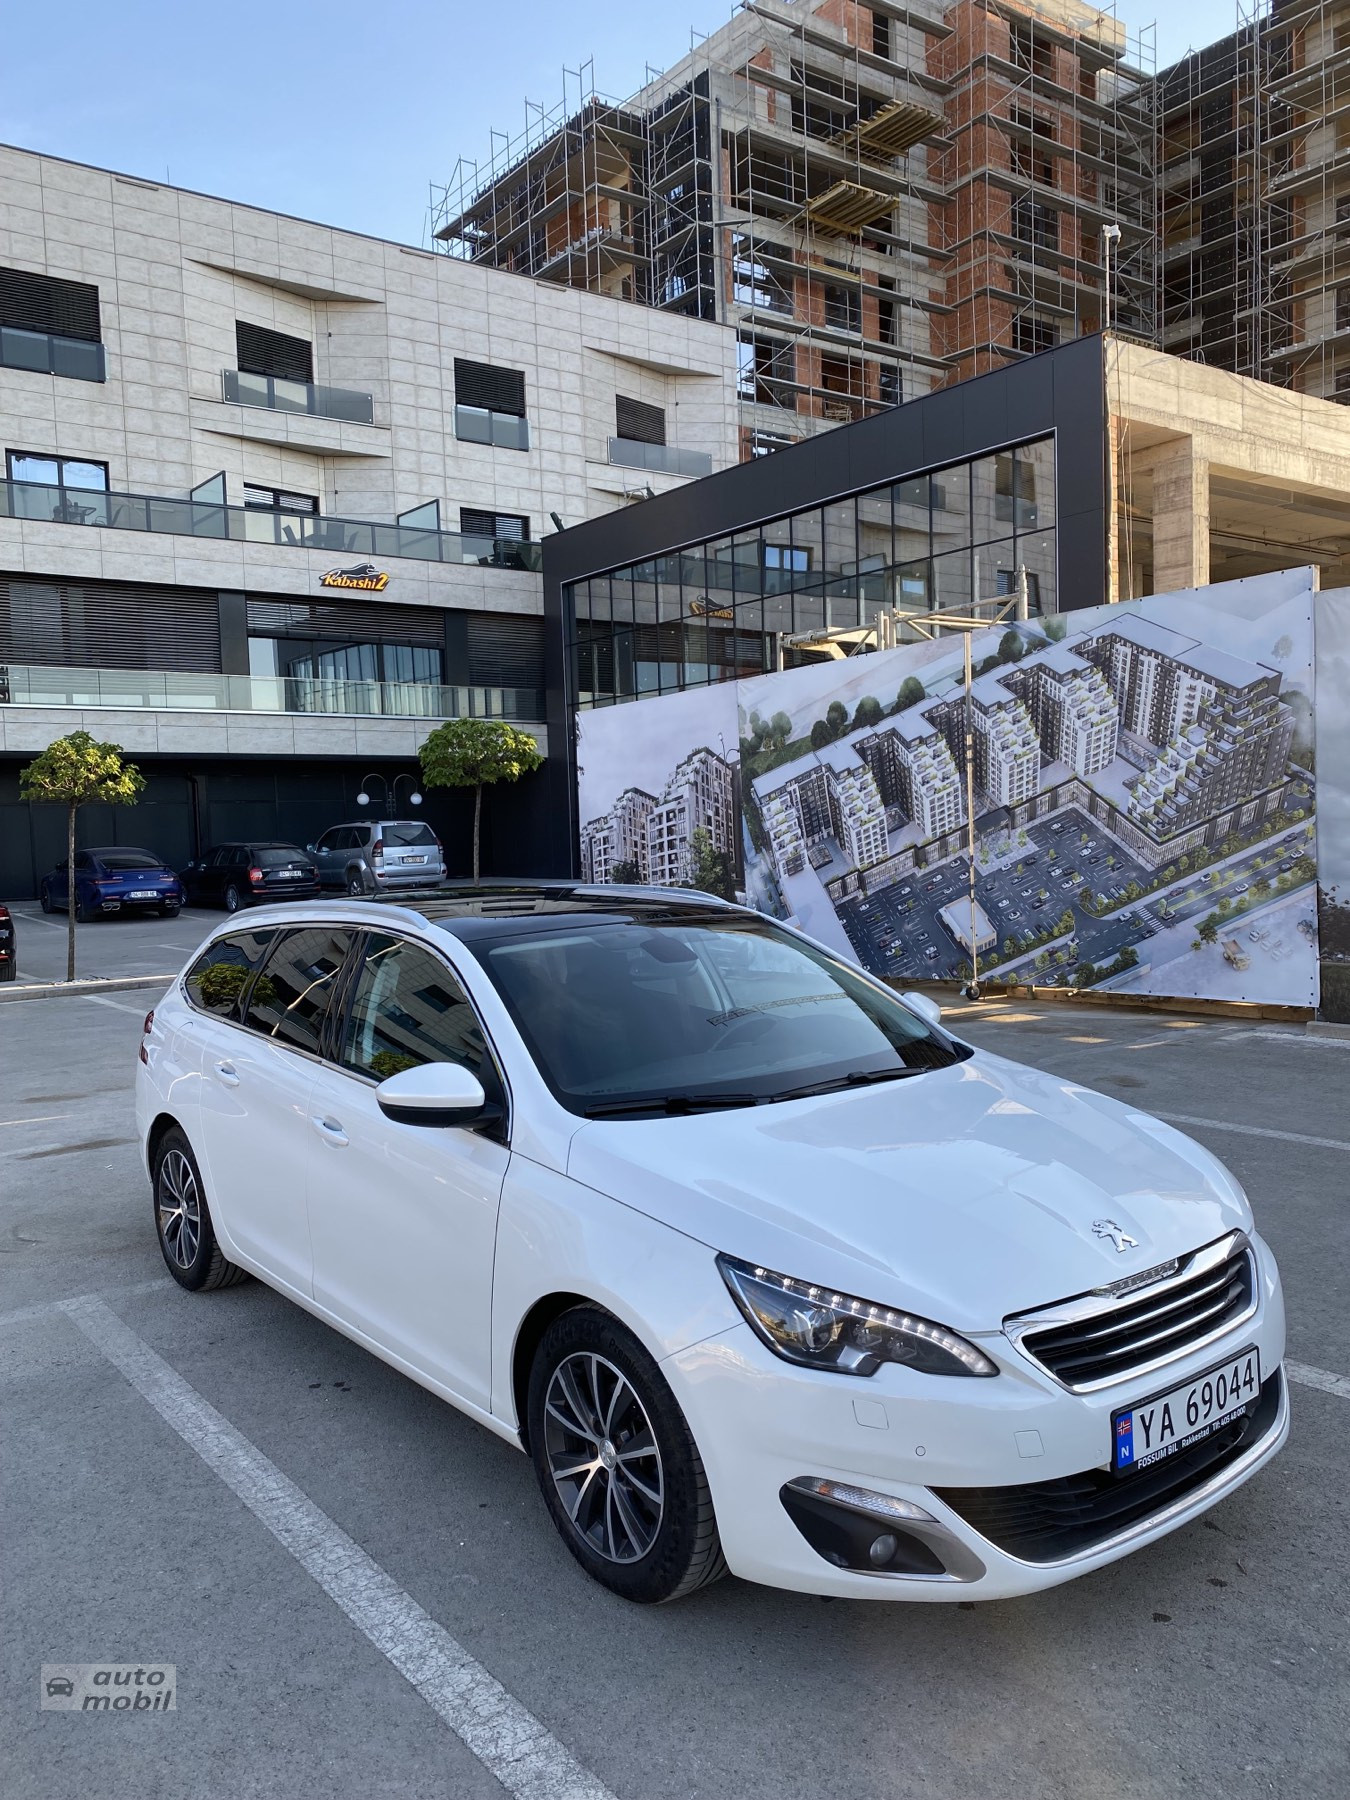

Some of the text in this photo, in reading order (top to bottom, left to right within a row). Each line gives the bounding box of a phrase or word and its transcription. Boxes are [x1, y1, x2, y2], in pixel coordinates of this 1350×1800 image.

[1138, 1357, 1254, 1449] YA 69044
[1121, 1445, 1129, 1458] N
[1137, 1447, 1167, 1470] FOSSUM
[1167, 1442, 1178, 1455] BIL
[1181, 1426, 1210, 1448] Rakkestad
